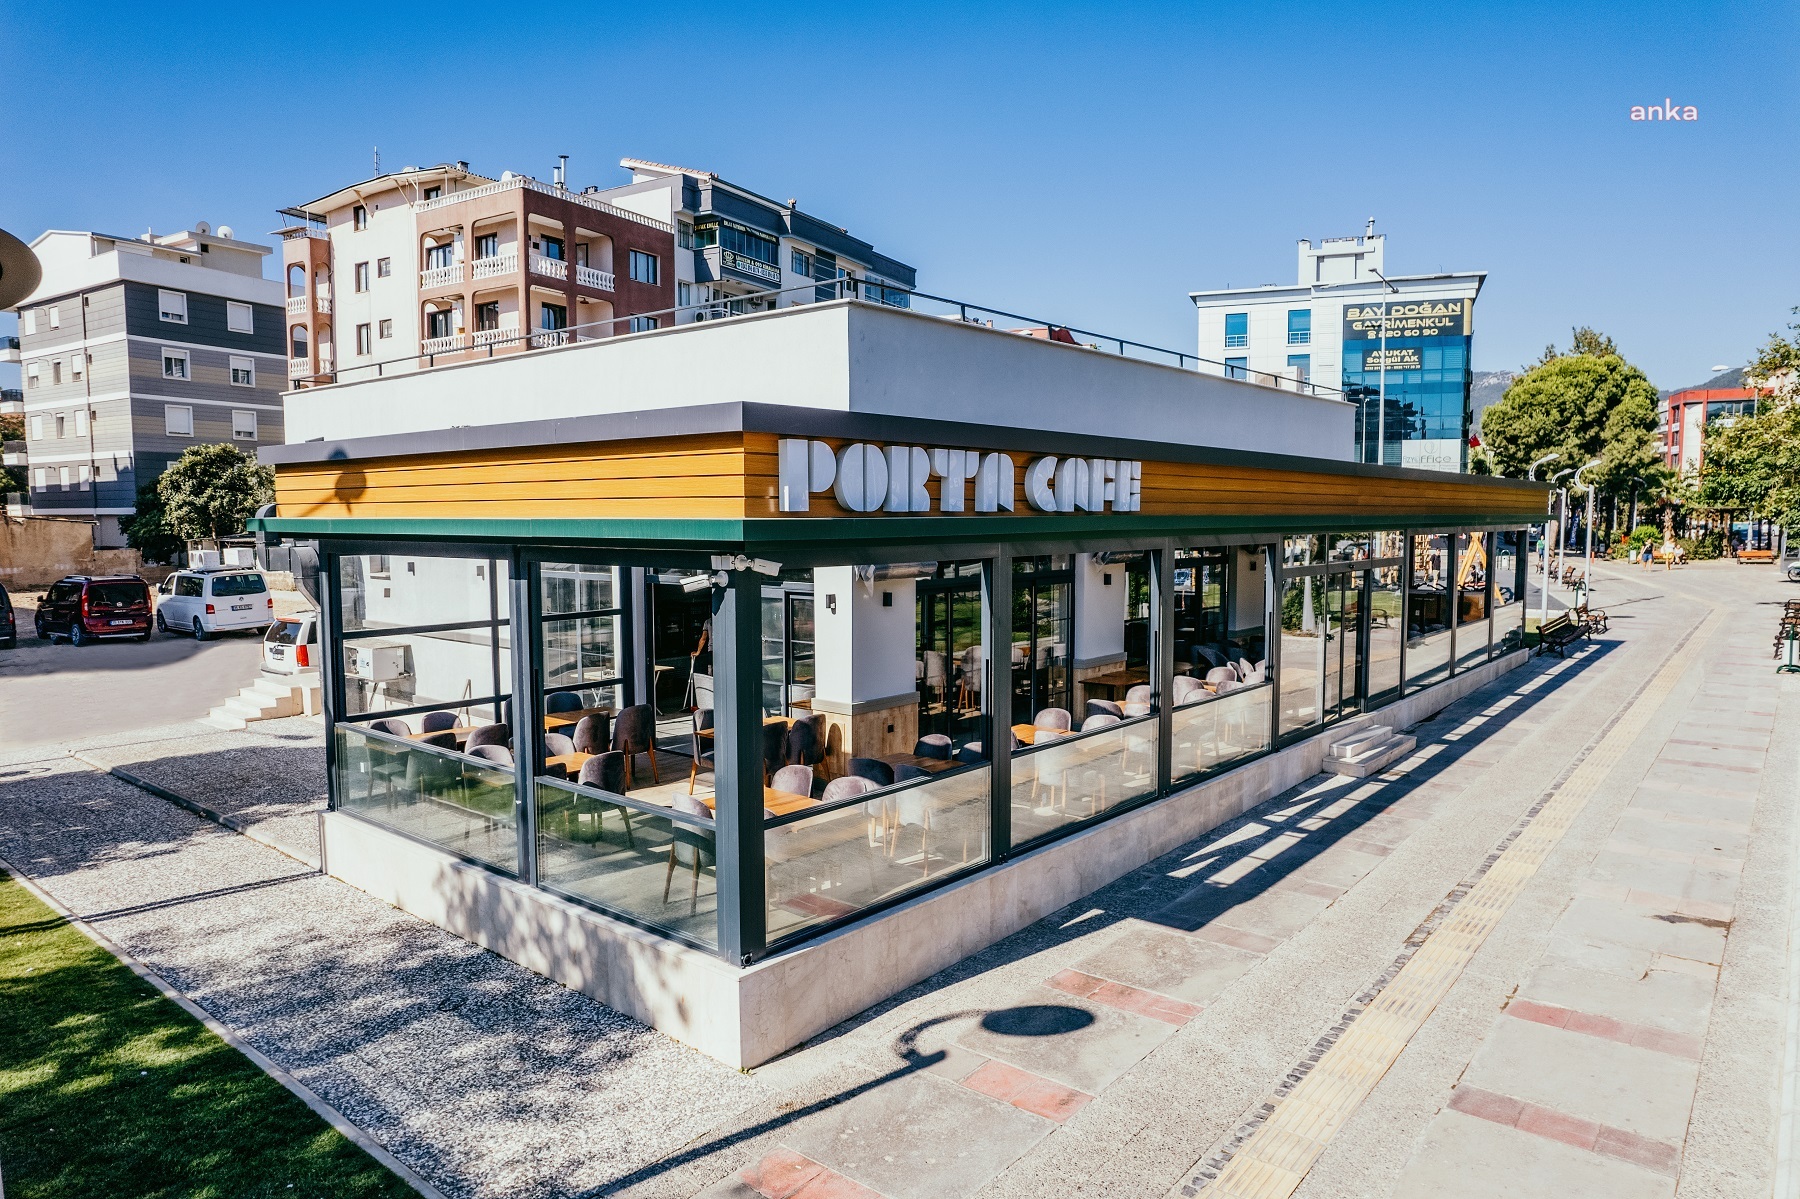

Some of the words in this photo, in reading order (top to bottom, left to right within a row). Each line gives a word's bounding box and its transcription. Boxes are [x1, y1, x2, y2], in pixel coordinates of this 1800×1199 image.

[1347, 306, 1386, 318] BAY
[1391, 302, 1461, 316] DOĞAN
[1404, 329, 1420, 337] 60
[1422, 328, 1439, 336] 90
[1366, 356, 1401, 364] Sogül
[778, 438, 1015, 512] PORTA
[1025, 455, 1142, 512] CAFE
